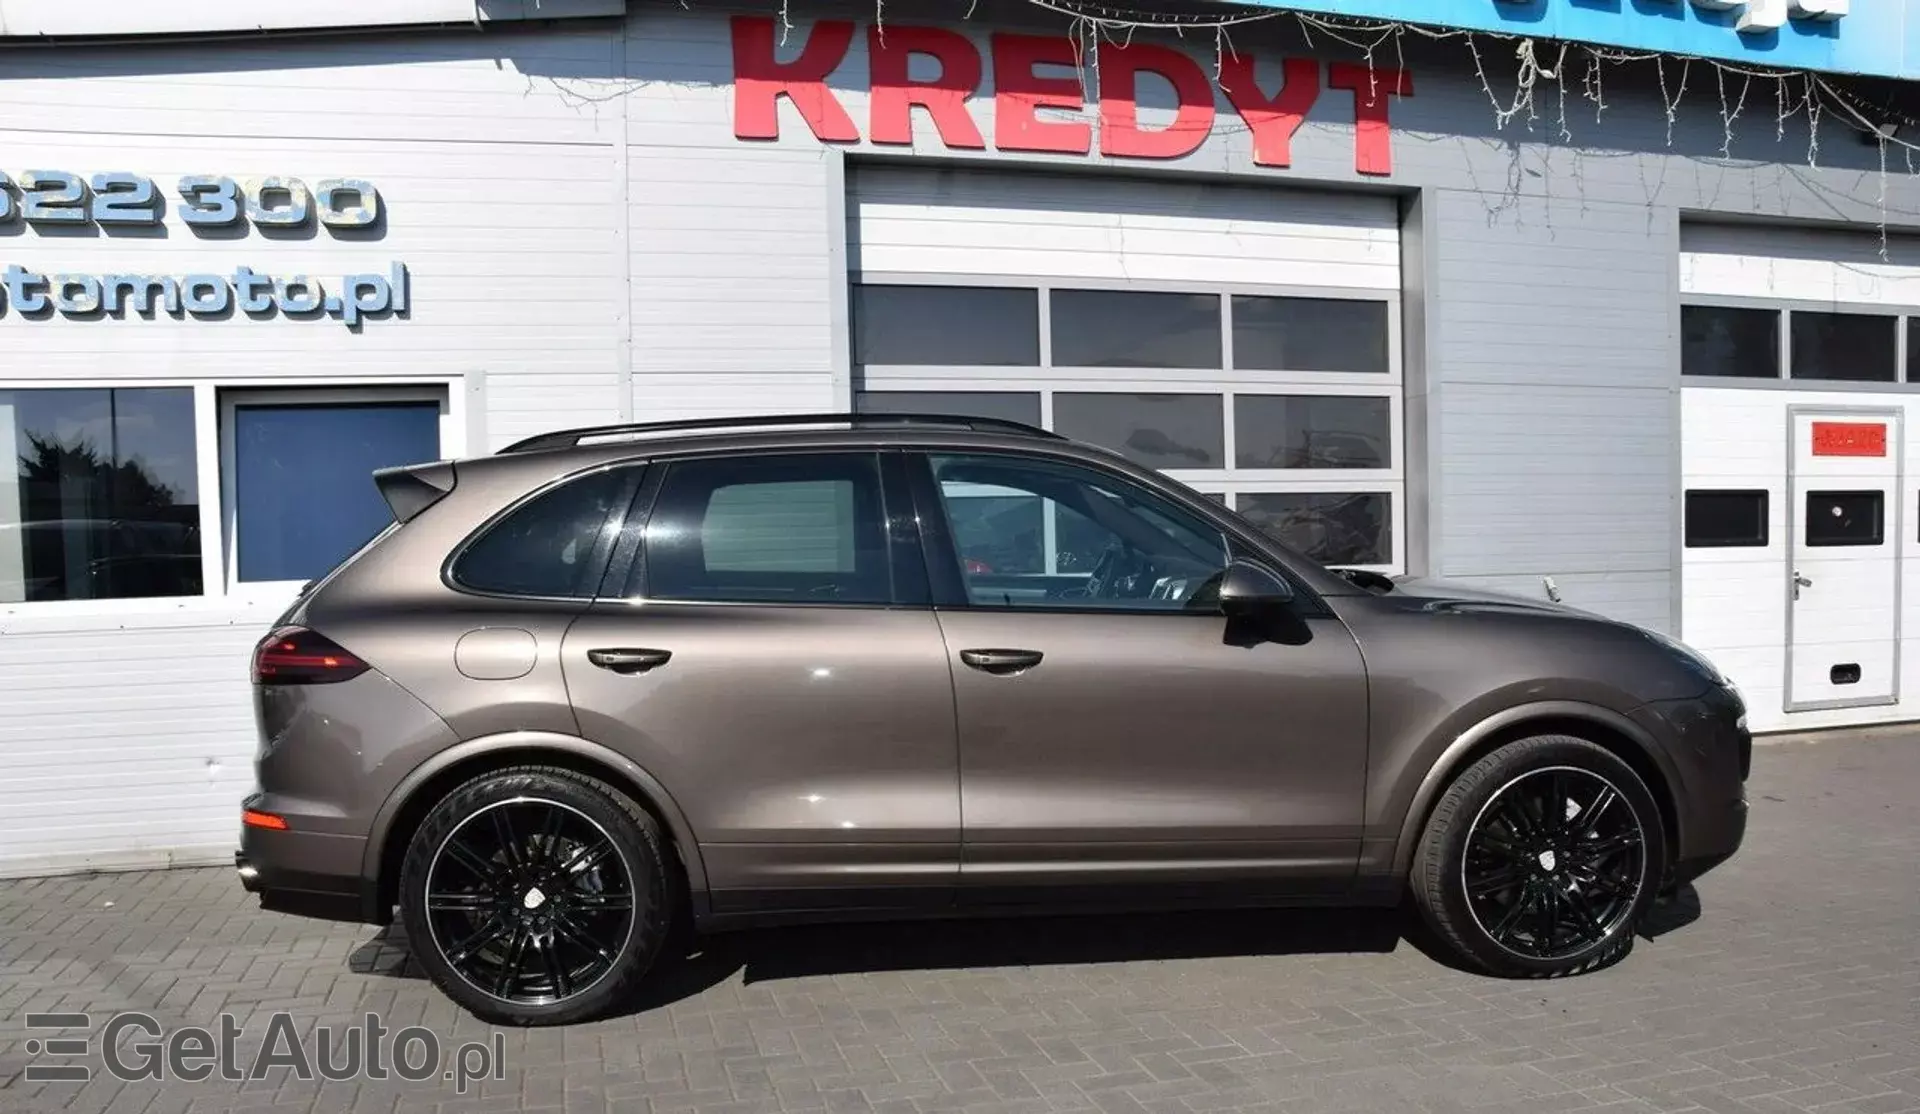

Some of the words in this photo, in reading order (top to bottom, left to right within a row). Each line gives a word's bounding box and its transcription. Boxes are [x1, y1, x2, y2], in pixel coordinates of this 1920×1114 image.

[730, 15, 1414, 176] KREDYT
[0, 169, 160, 224] 22
[178, 174, 382, 228] 300
[0, 260, 408, 326] tomoto.pl
